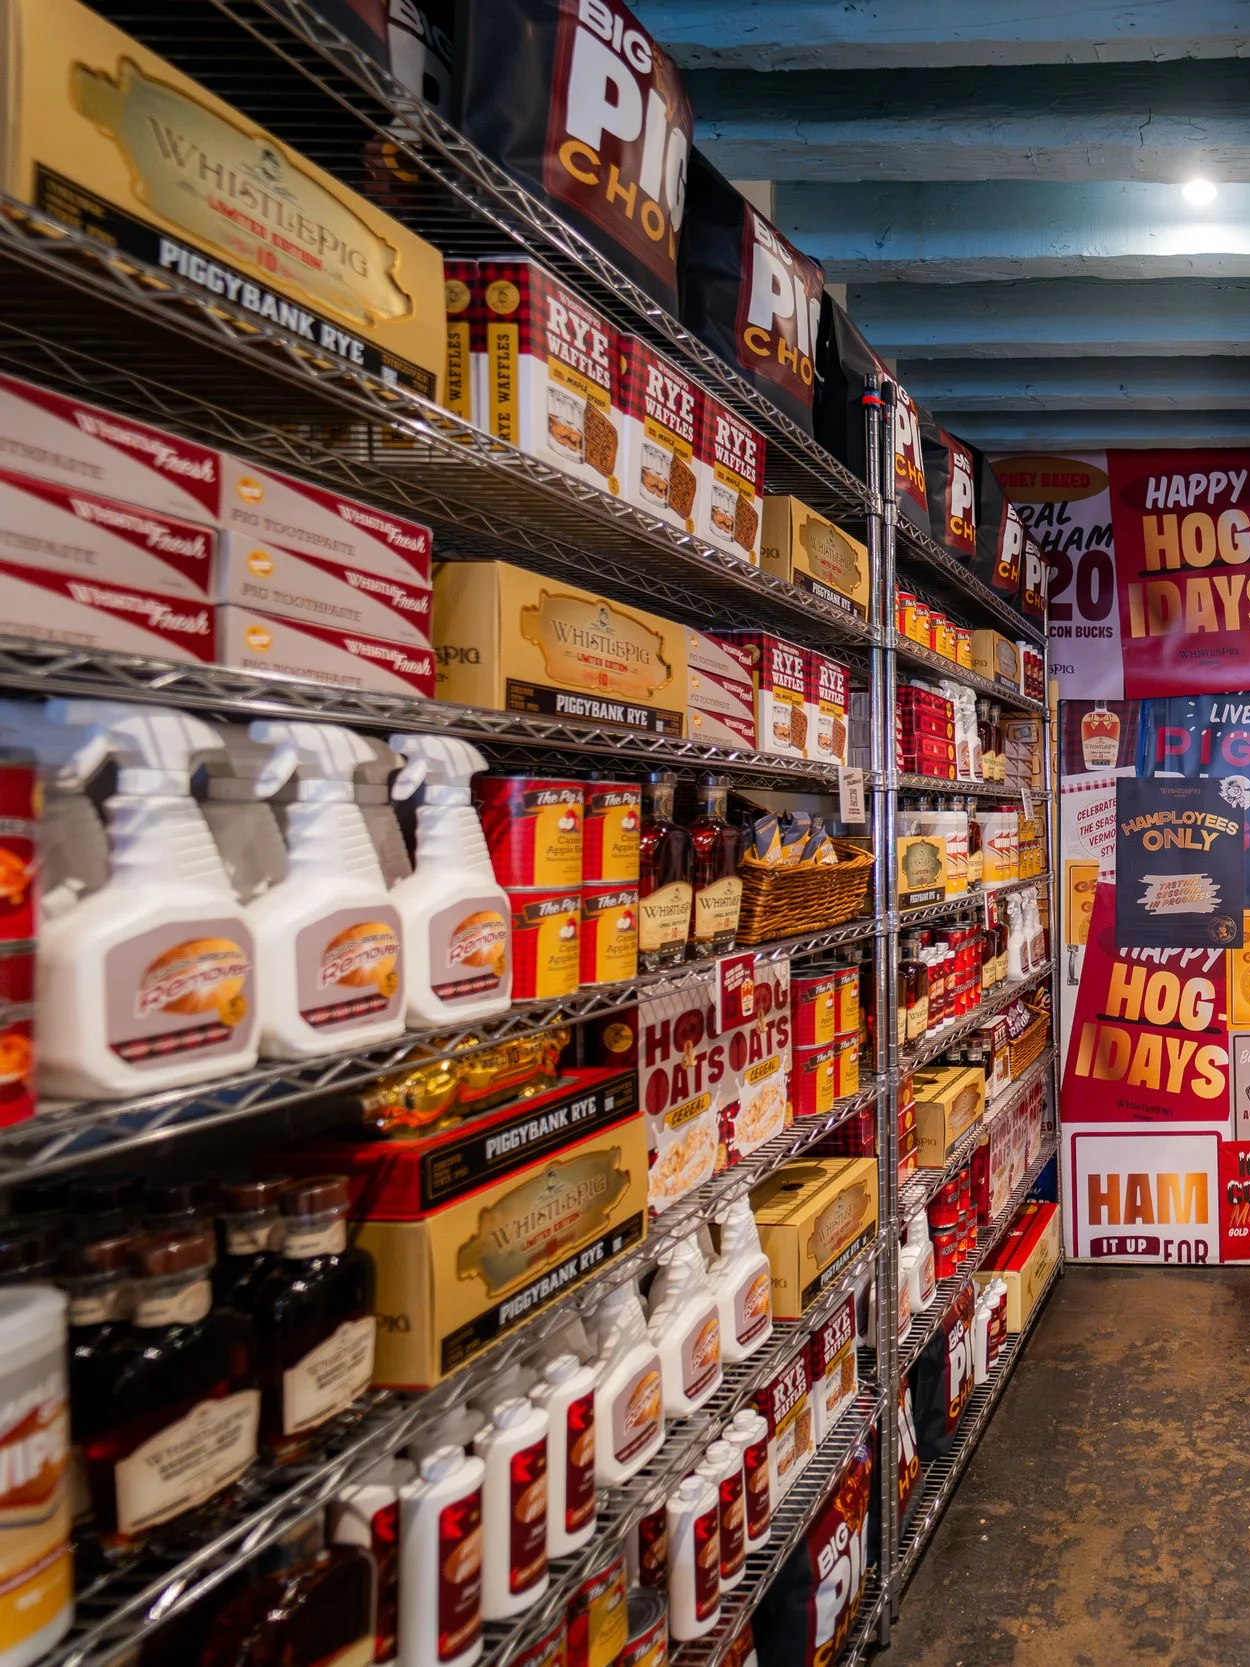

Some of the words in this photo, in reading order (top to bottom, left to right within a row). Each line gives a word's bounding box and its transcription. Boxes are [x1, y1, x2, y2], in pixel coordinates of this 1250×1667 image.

[578, 0, 653, 75] BIG
[752, 212, 793, 265] BIG
[159, 236, 316, 341] PIGGYBANK
[319, 324, 365, 364] RYE
[547, 295, 609, 361] RYE
[449, 331, 461, 400] WAFFLES
[546, 333, 611, 390] WAFFLES
[647, 364, 695, 420] RYE
[645, 395, 694, 444] WAFFLES
[716, 415, 758, 467] RYE
[714, 442, 756, 485] WAFFLES
[1144, 468, 1248, 510] HAPPY
[551, 619, 650, 666] WHISTLEPIG
[772, 648, 804, 679] RYE
[772, 671, 804, 693] WAFFLES
[818, 685, 845, 706] WAFFLES
[819, 665, 845, 693] RYE
[555, 694, 625, 722] PIGGYBANK
[627, 707, 648, 727] RYE
[536, 791, 558, 806] The
[559, 789, 577, 809] Pig
[1076, 798, 1117, 822] CELEBRATE
[1120, 811, 1240, 837] HAMPLOYEES
[1142, 827, 1220, 852] ONLY
[1149, 900, 1160, 909] IN
[1161, 891, 1212, 908] PROGRESS
[1155, 884, 1203, 899] SESSIONS
[1159, 878, 1200, 890] TASTING
[539, 901, 560, 913] The
[561, 898, 577, 917] Pig
[320, 942, 401, 990] Remover
[728, 1015, 789, 1073] OATS
[1074, 1022, 1230, 1100] IDAYS
[645, 1044, 726, 1117] OATS
[750, 1059, 776, 1082] CEREAL
[485, 1106, 569, 1161] PIGGYBANK
[571, 1096, 597, 1124] RYE
[671, 1098, 707, 1126] CEREAL
[1087, 1172, 1209, 1226] HAM
[1227, 1226, 1249, 1238] GOLD
[498, 1257, 579, 1326] PIGGYBANK
[579, 1240, 605, 1271] RYE
[823, 1305, 851, 1350] RYE
[823, 1326, 852, 1367] WAFFLES
[772, 1356, 807, 1411] RYE
[773, 1377, 808, 1426] WAFFLES
[817, 1521, 849, 1580] BIG
